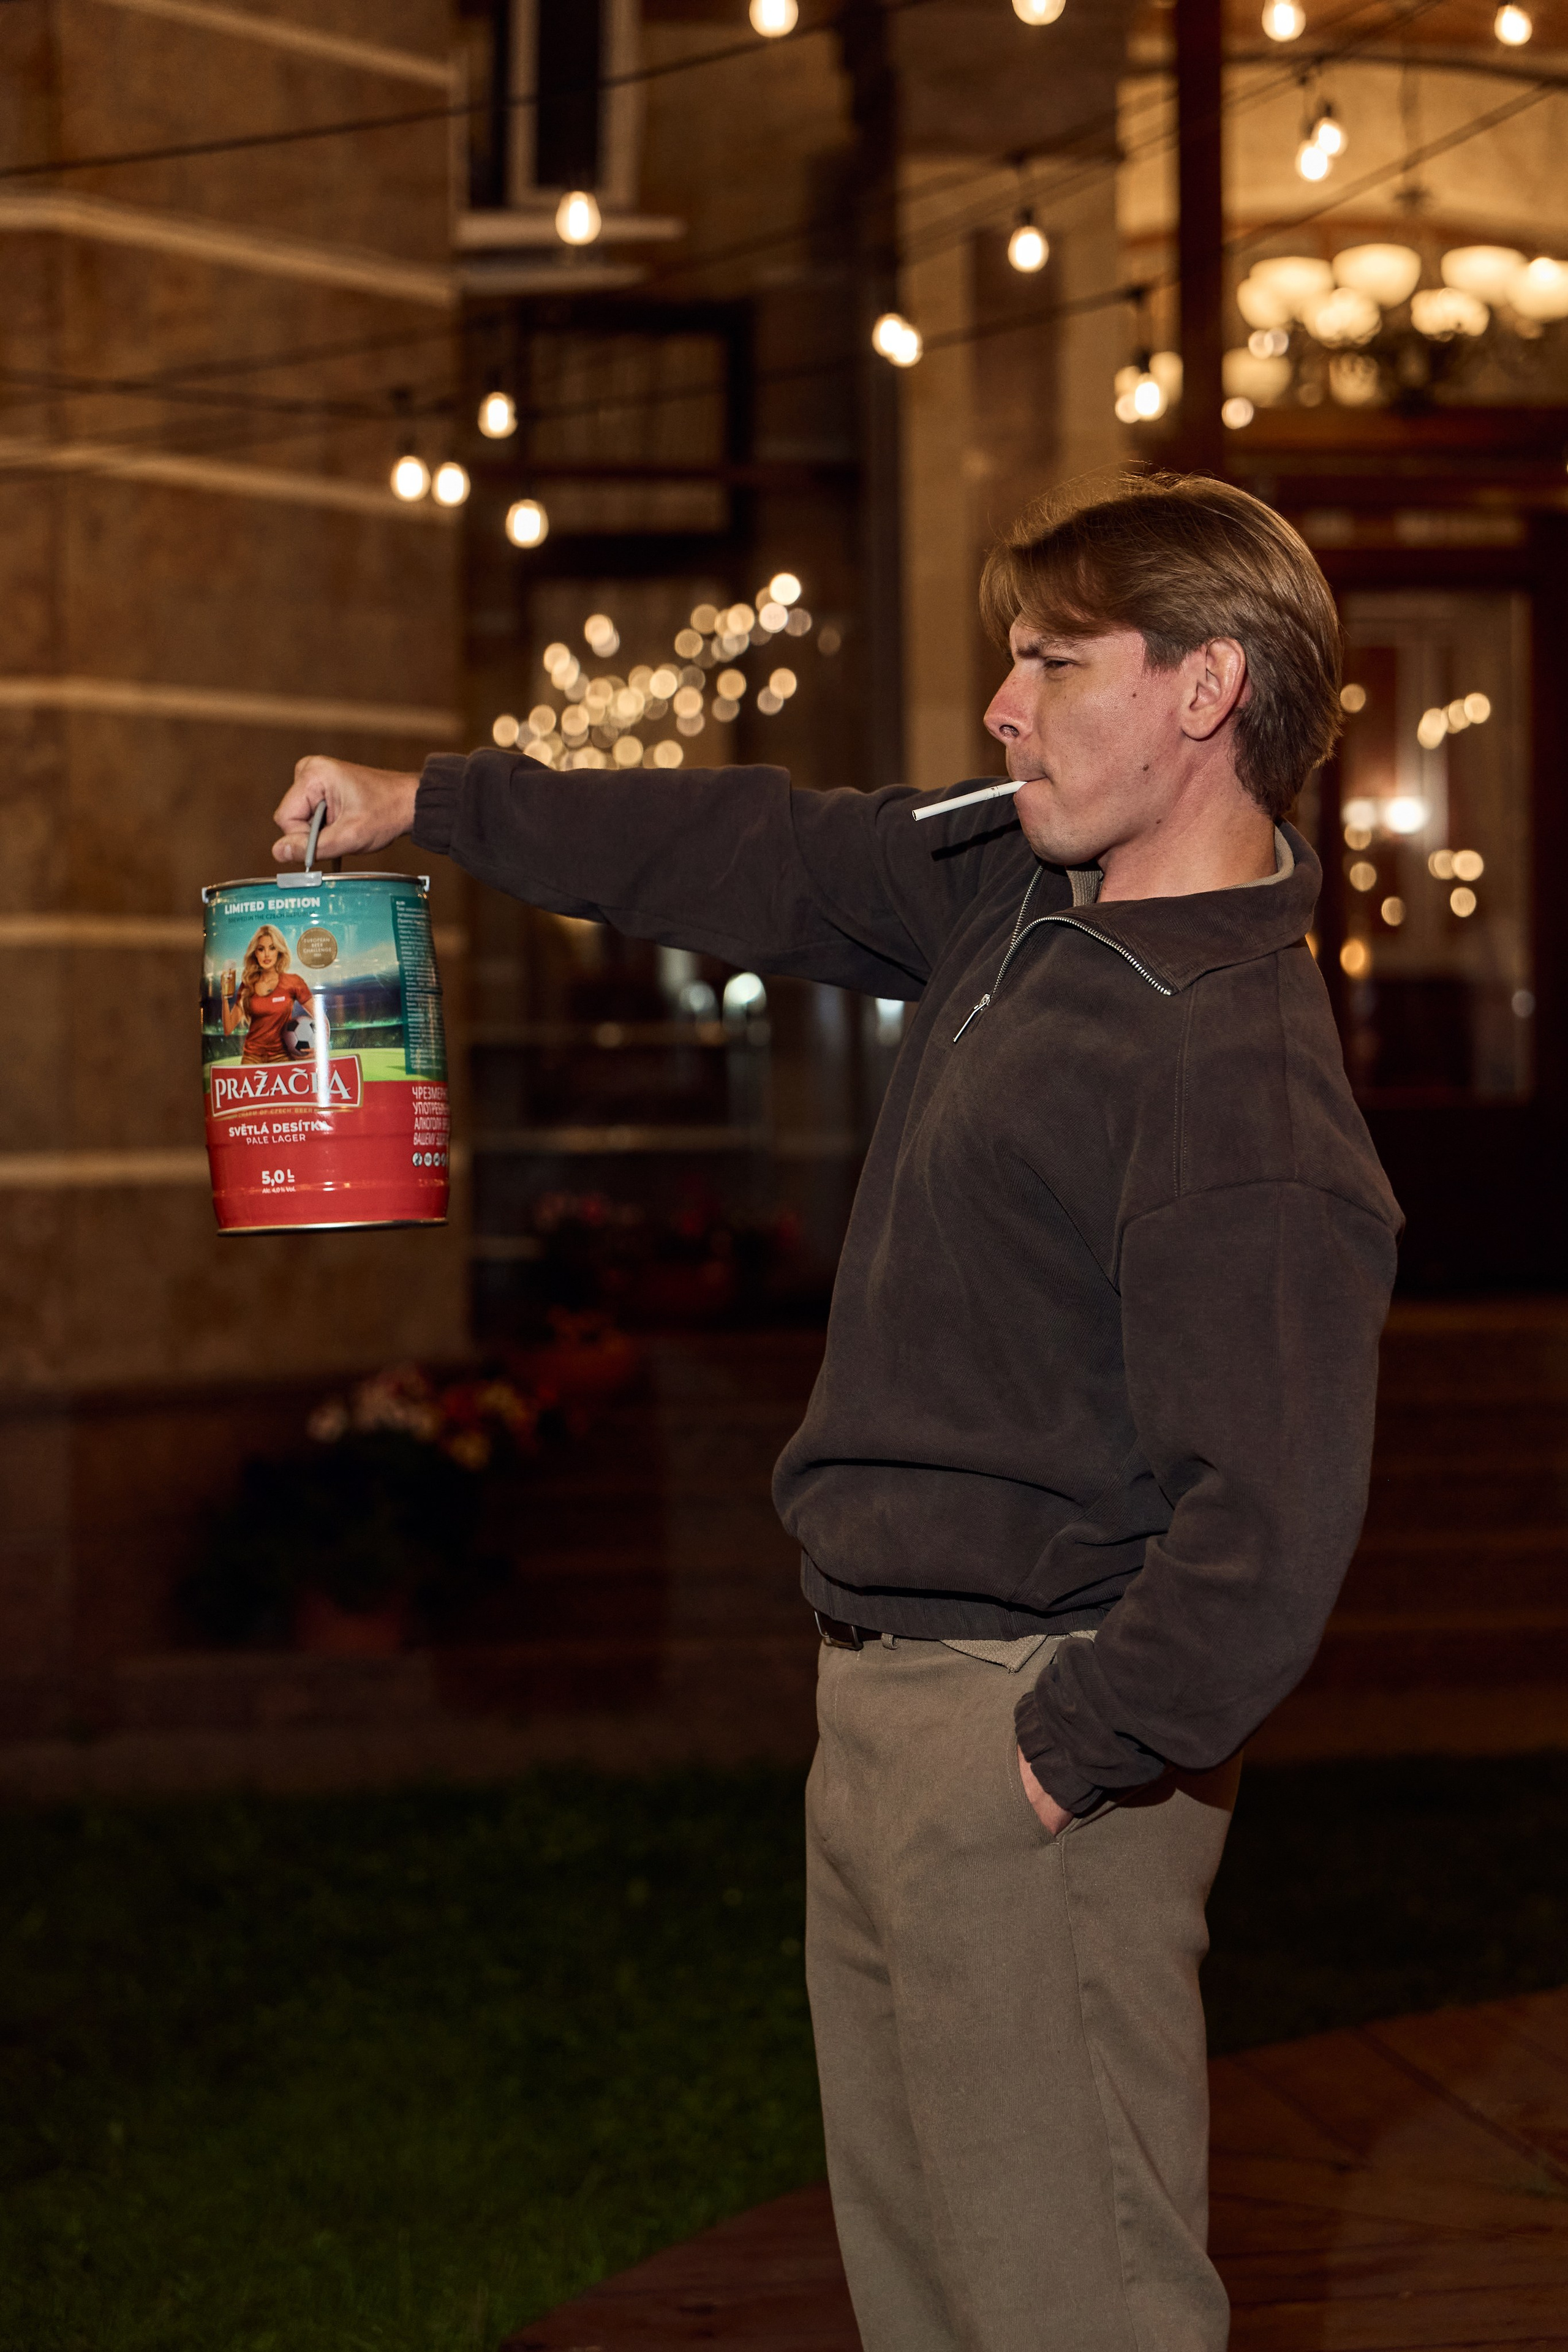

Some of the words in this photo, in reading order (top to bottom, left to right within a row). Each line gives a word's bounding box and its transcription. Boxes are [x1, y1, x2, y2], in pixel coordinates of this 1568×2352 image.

[224, 900, 265, 915] LIMITED
[268, 897, 320, 910] EDITION
[228, 1121, 270, 1137] SVĚTLÁ
[246, 1136, 269, 1145] PALE
[272, 1133, 306, 1144] LAGER
[262, 1169, 285, 1186] 5,0
